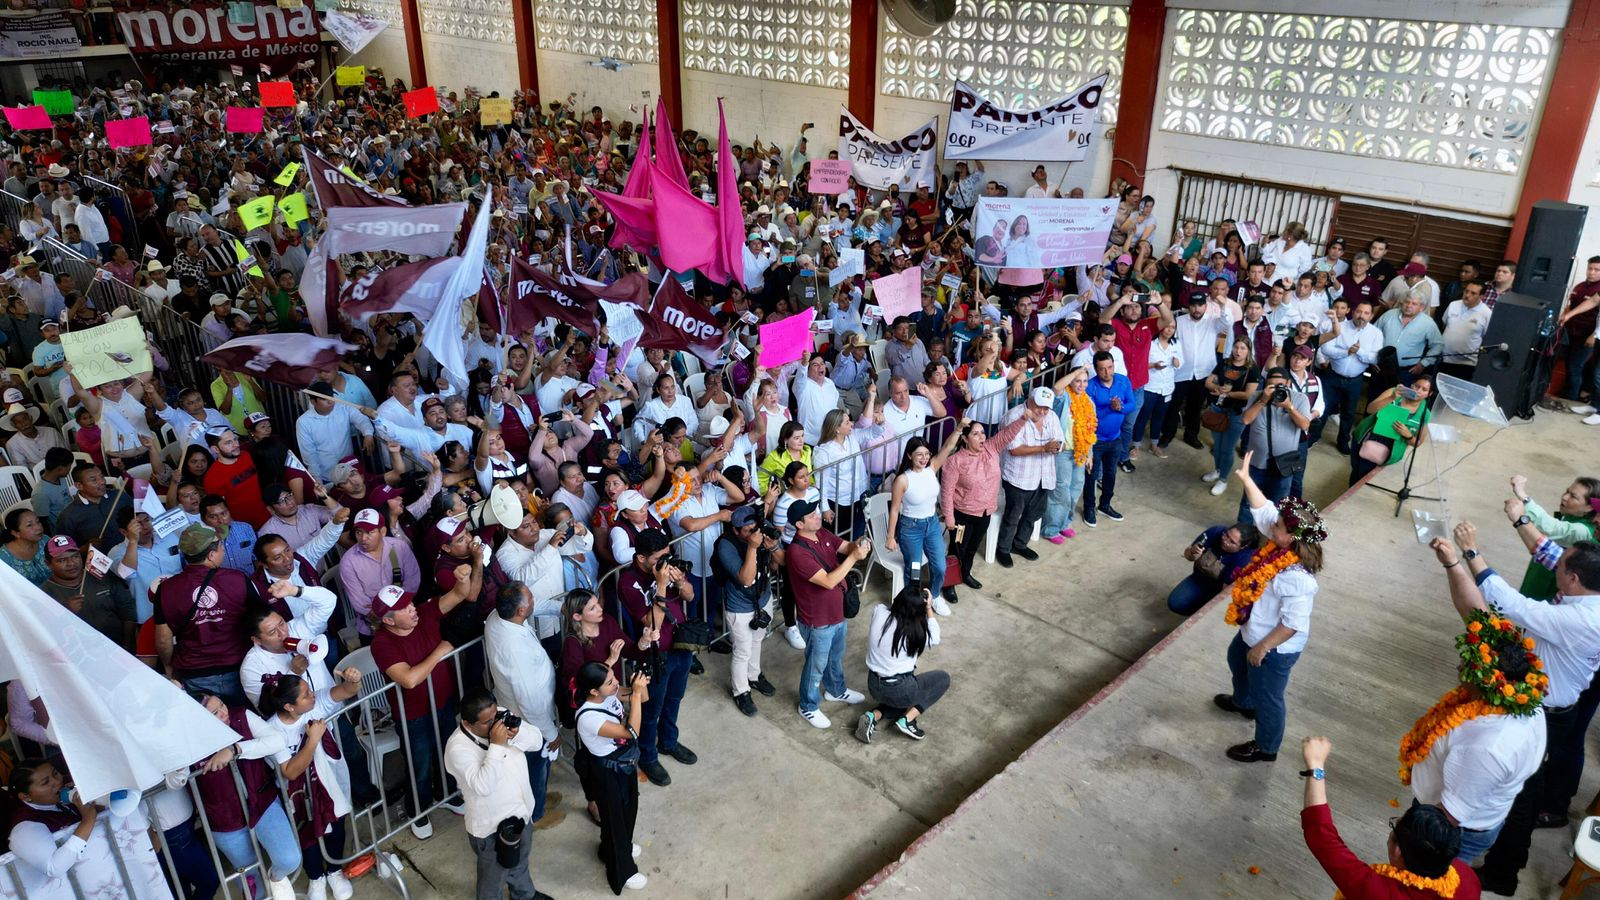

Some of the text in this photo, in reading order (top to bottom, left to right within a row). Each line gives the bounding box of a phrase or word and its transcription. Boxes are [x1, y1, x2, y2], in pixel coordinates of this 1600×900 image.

[117, 3, 317, 47] morena
[48, 37, 78, 46] NAHLE
[242, 45, 260, 58] de
[266, 42, 319, 56] México
[949, 133, 977, 147] OGP
[82, 341, 112, 355] CON
[157, 515, 186, 533] morena
